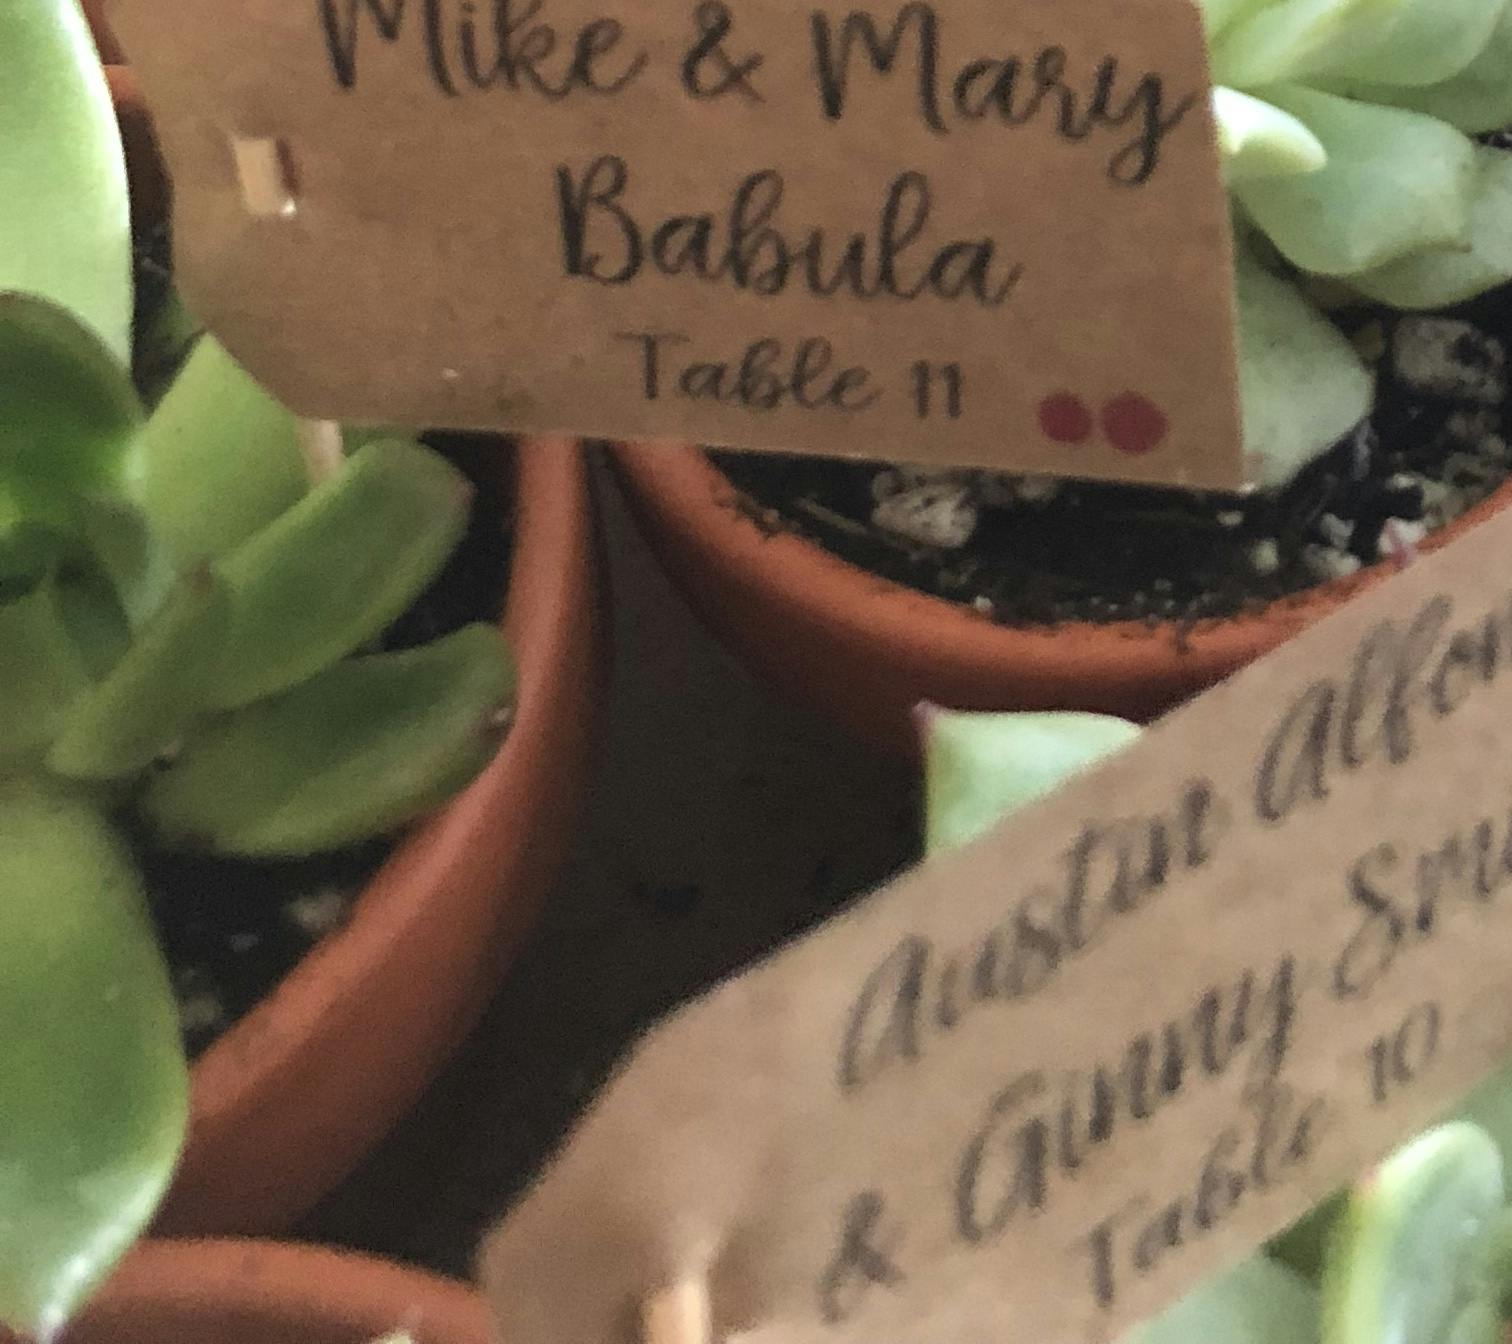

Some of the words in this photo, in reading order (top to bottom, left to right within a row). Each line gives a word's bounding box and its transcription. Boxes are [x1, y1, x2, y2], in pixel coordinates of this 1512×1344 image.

[809, 0, 1200, 189] Mary
[554, 155, 1023, 309] Babula
[613, 330, 884, 412] Table
[910, 361, 964, 420] 11
[832, 771, 1230, 1099] Austin
[815, 1189, 908, 1322] &
[950, 951, 1302, 1247] Ginny
[1078, 1071, 1328, 1308] Table
[1361, 1000, 1440, 1109] 10
